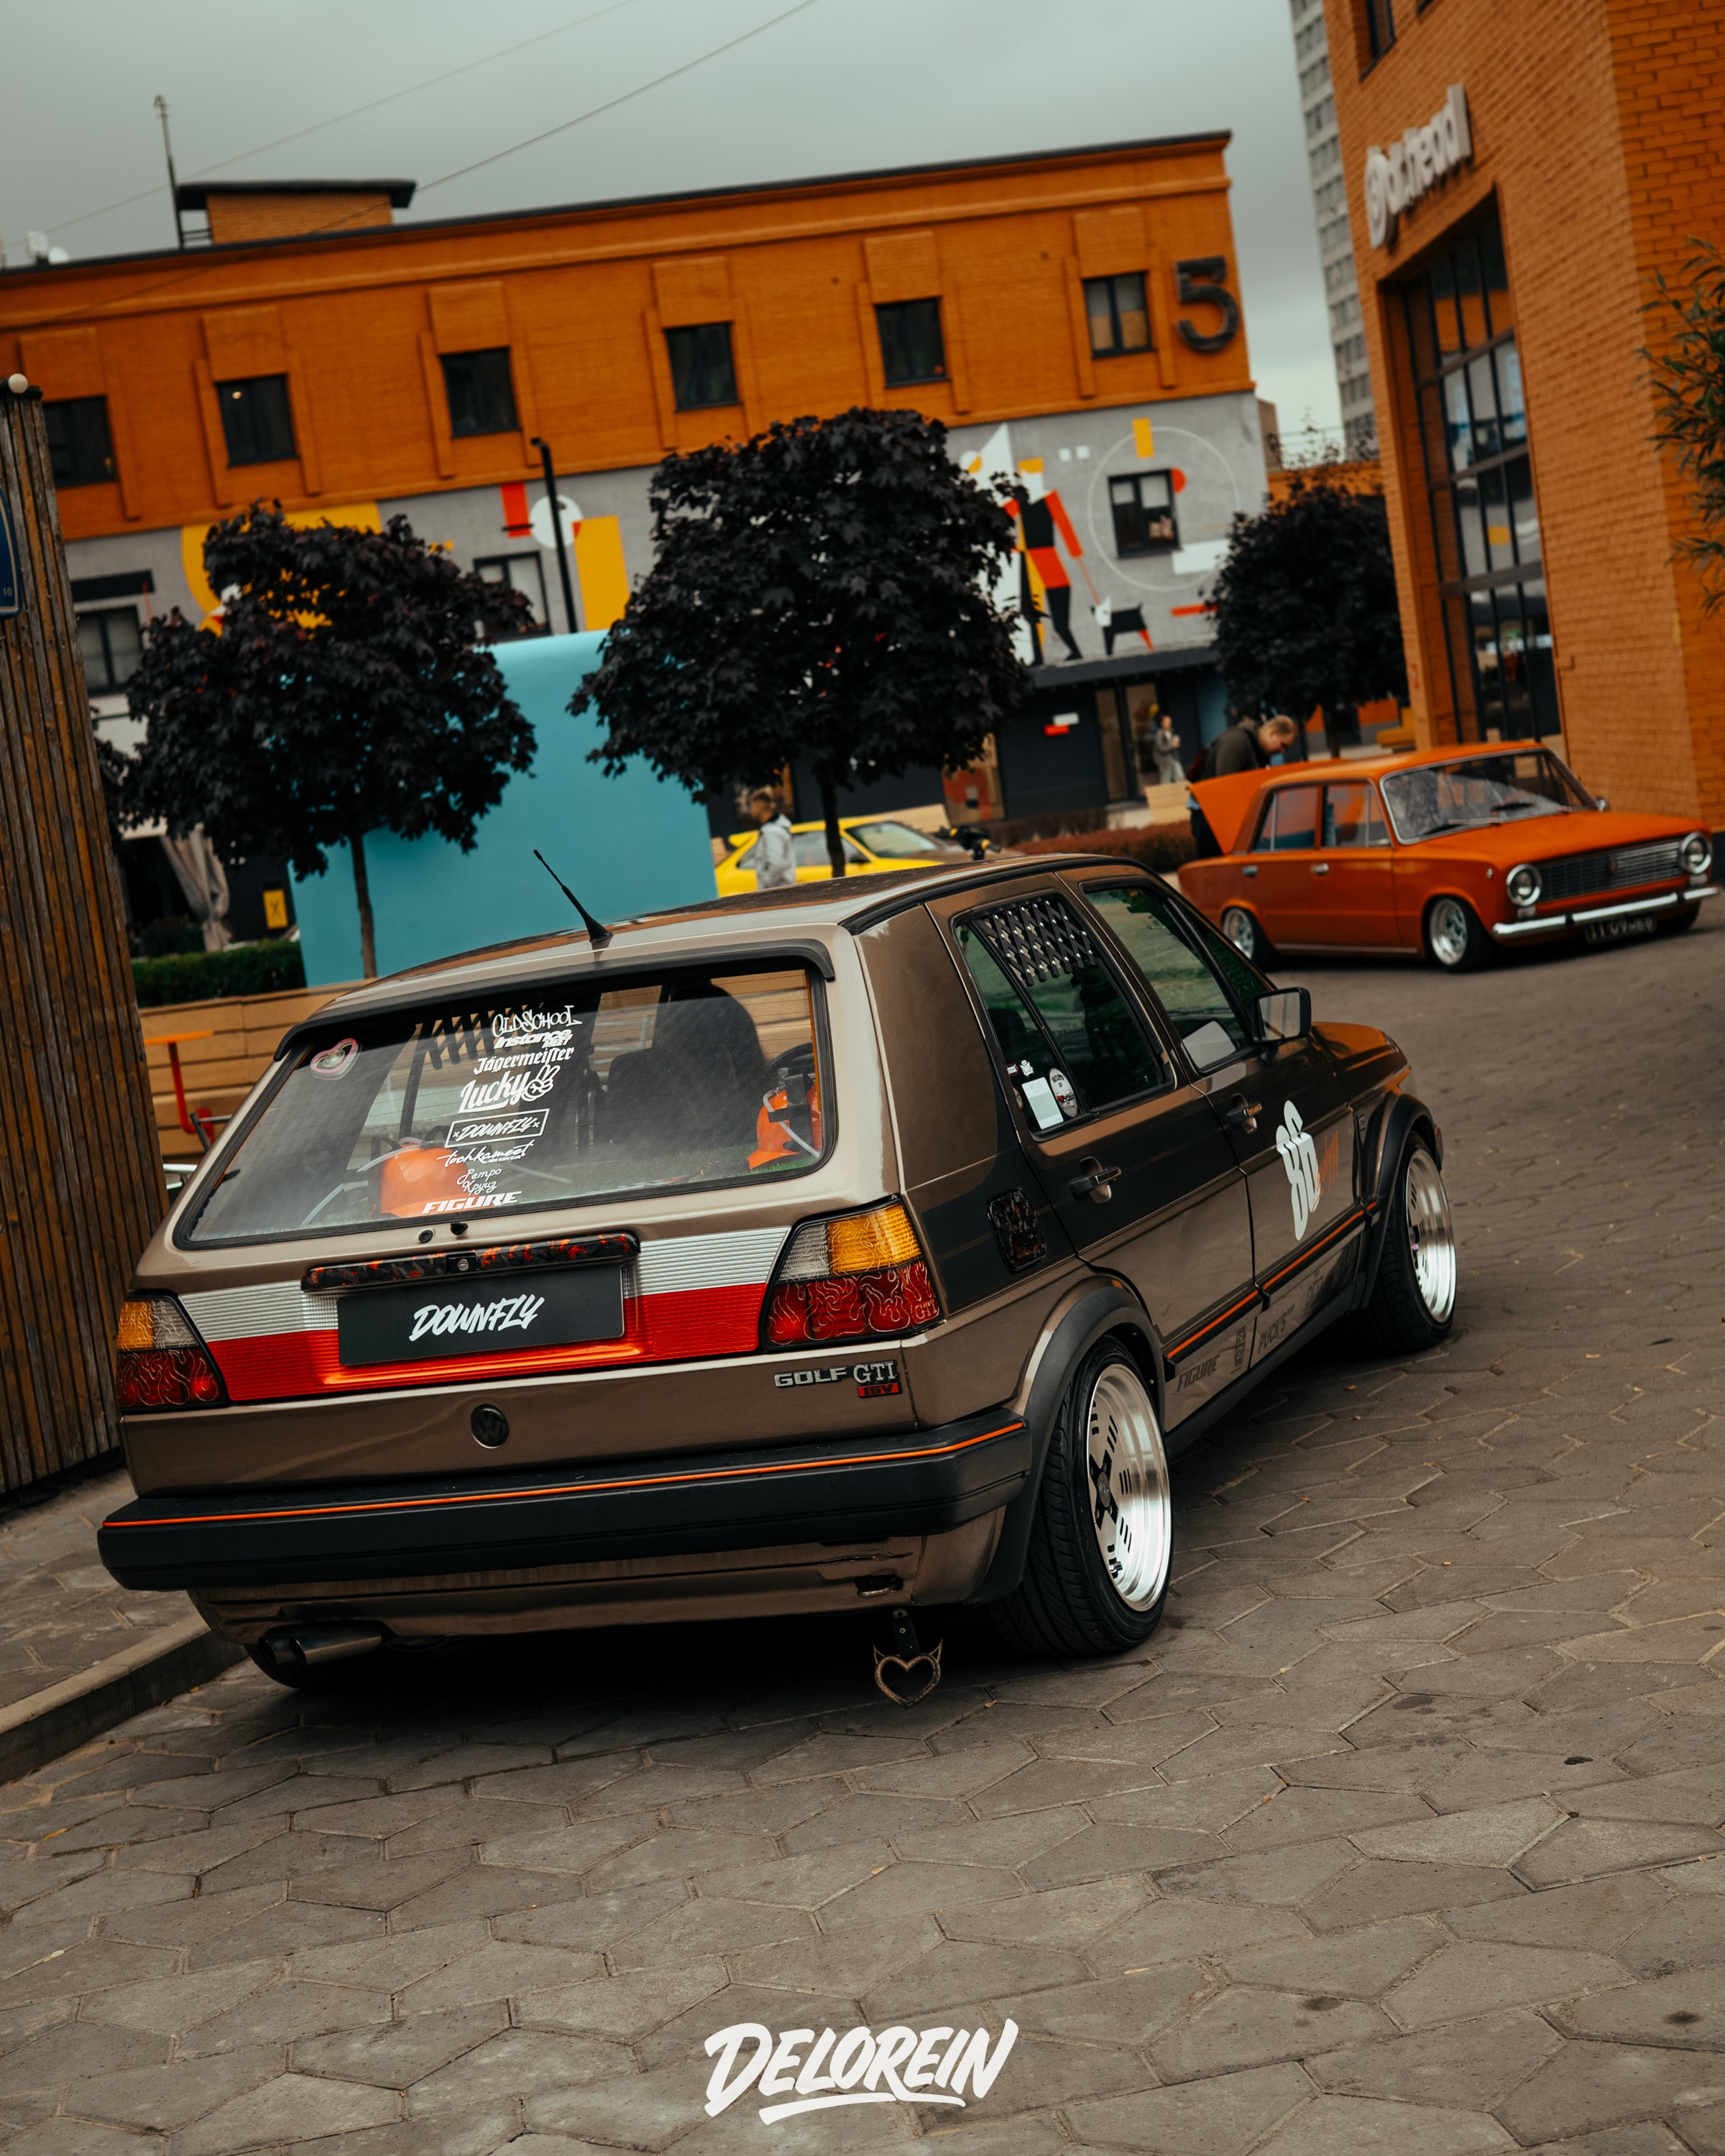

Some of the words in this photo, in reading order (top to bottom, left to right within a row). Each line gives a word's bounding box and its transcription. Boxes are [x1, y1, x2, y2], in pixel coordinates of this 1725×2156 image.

[1175, 256, 1239, 355] 5
[473, 1046, 574, 1075] Jägermeister
[457, 1070, 530, 1114] Lucky
[455, 1115, 538, 1142] DOWNFLY
[456, 1168, 502, 1185] Ретро
[421, 1190, 523, 1215] FIGURE
[408, 1294, 545, 1342] DOWNFLY
[914, 1299, 937, 1319] GTI
[774, 1366, 847, 1387] GOLF
[853, 1362, 897, 1383] GTI
[1177, 1354, 1220, 1393] FIGURE
[862, 1384, 894, 1396] 16V
